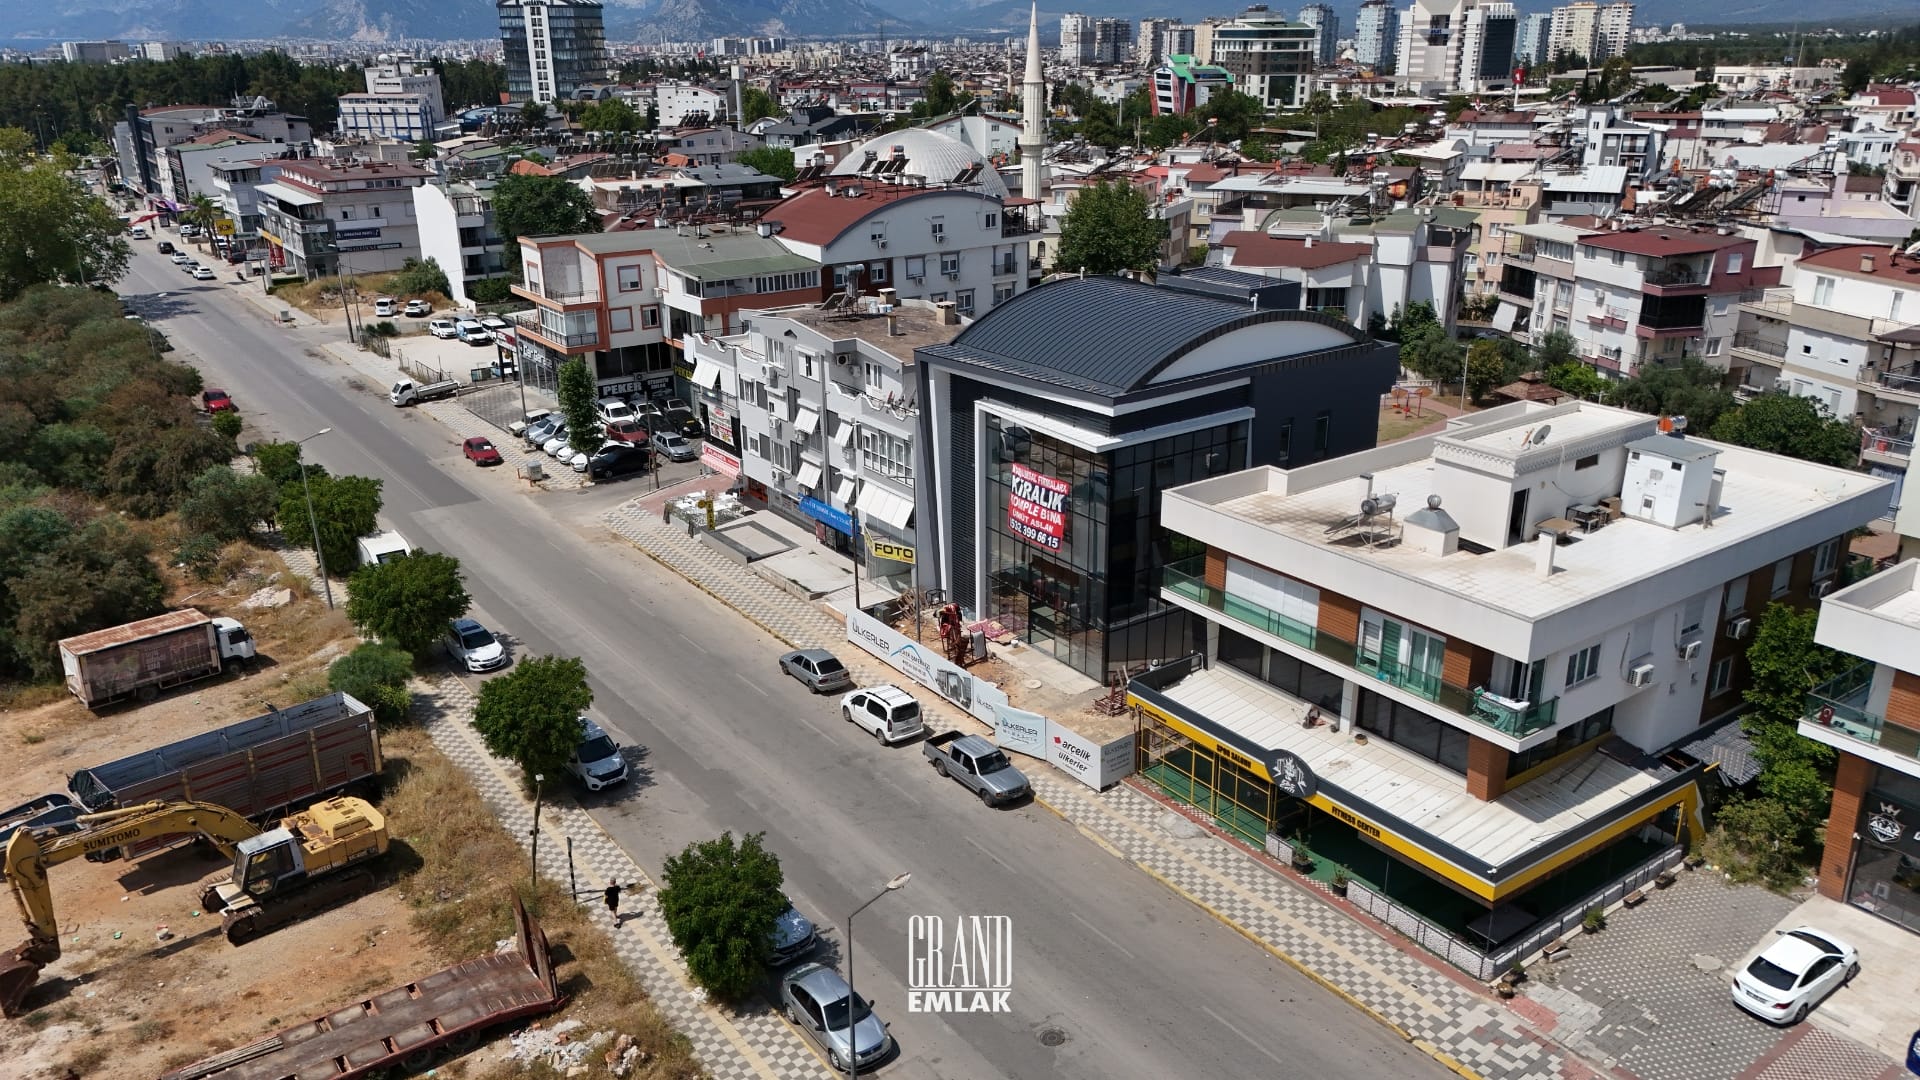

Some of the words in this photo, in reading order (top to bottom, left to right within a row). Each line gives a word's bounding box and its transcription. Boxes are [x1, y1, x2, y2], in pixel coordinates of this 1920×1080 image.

[602, 381, 642, 396] PEKER
[1022, 525, 1037, 540] 399
[1036, 531, 1047, 544] 66
[1047, 537, 1059, 549] 15
[874, 542, 914, 559] FOTO
[1062, 741, 1091, 761] arçelik
[1356, 819, 1380, 839] CENTER
[83, 828, 140, 851] SUMITOMO
